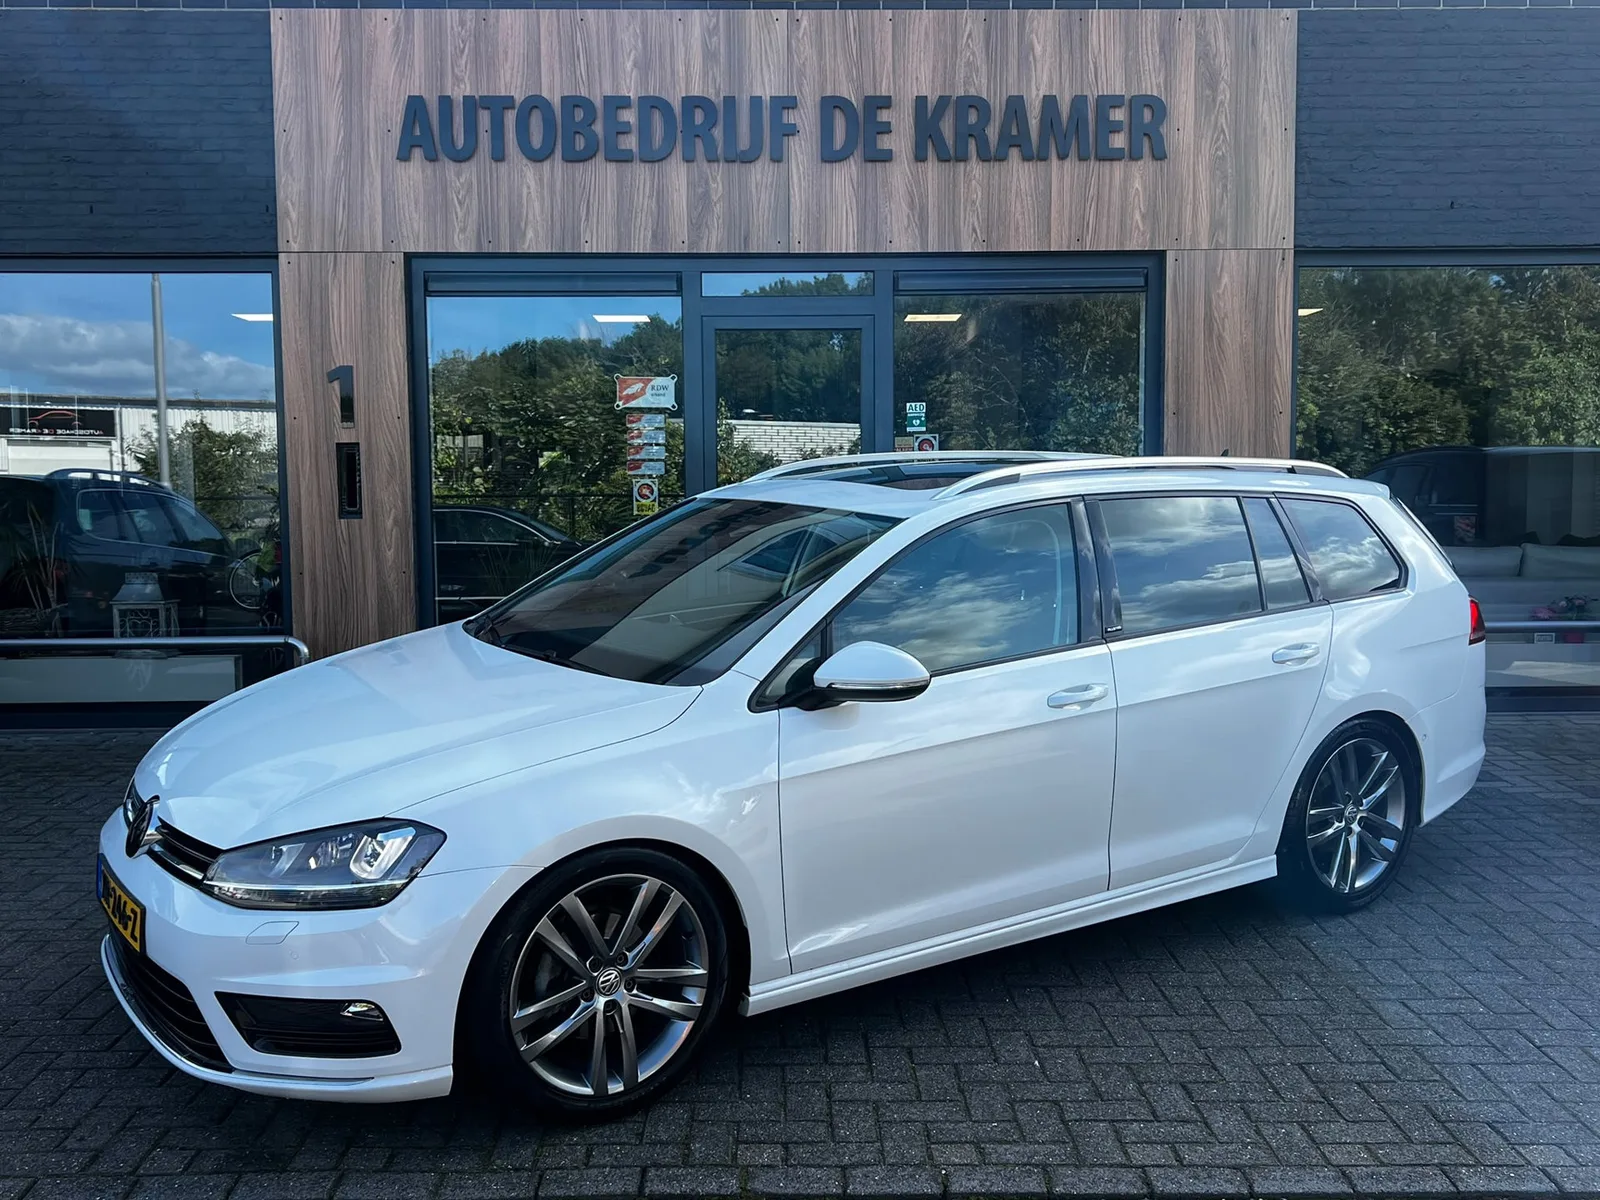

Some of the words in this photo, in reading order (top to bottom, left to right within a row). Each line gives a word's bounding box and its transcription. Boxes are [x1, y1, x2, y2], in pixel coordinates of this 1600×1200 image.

[396, 95, 798, 162] AUTOBEDRIJF
[820, 95, 892, 161] DE
[915, 95, 1167, 161] KRAMER
[326, 364, 355, 429] 1
[908, 403, 925, 412] AED
